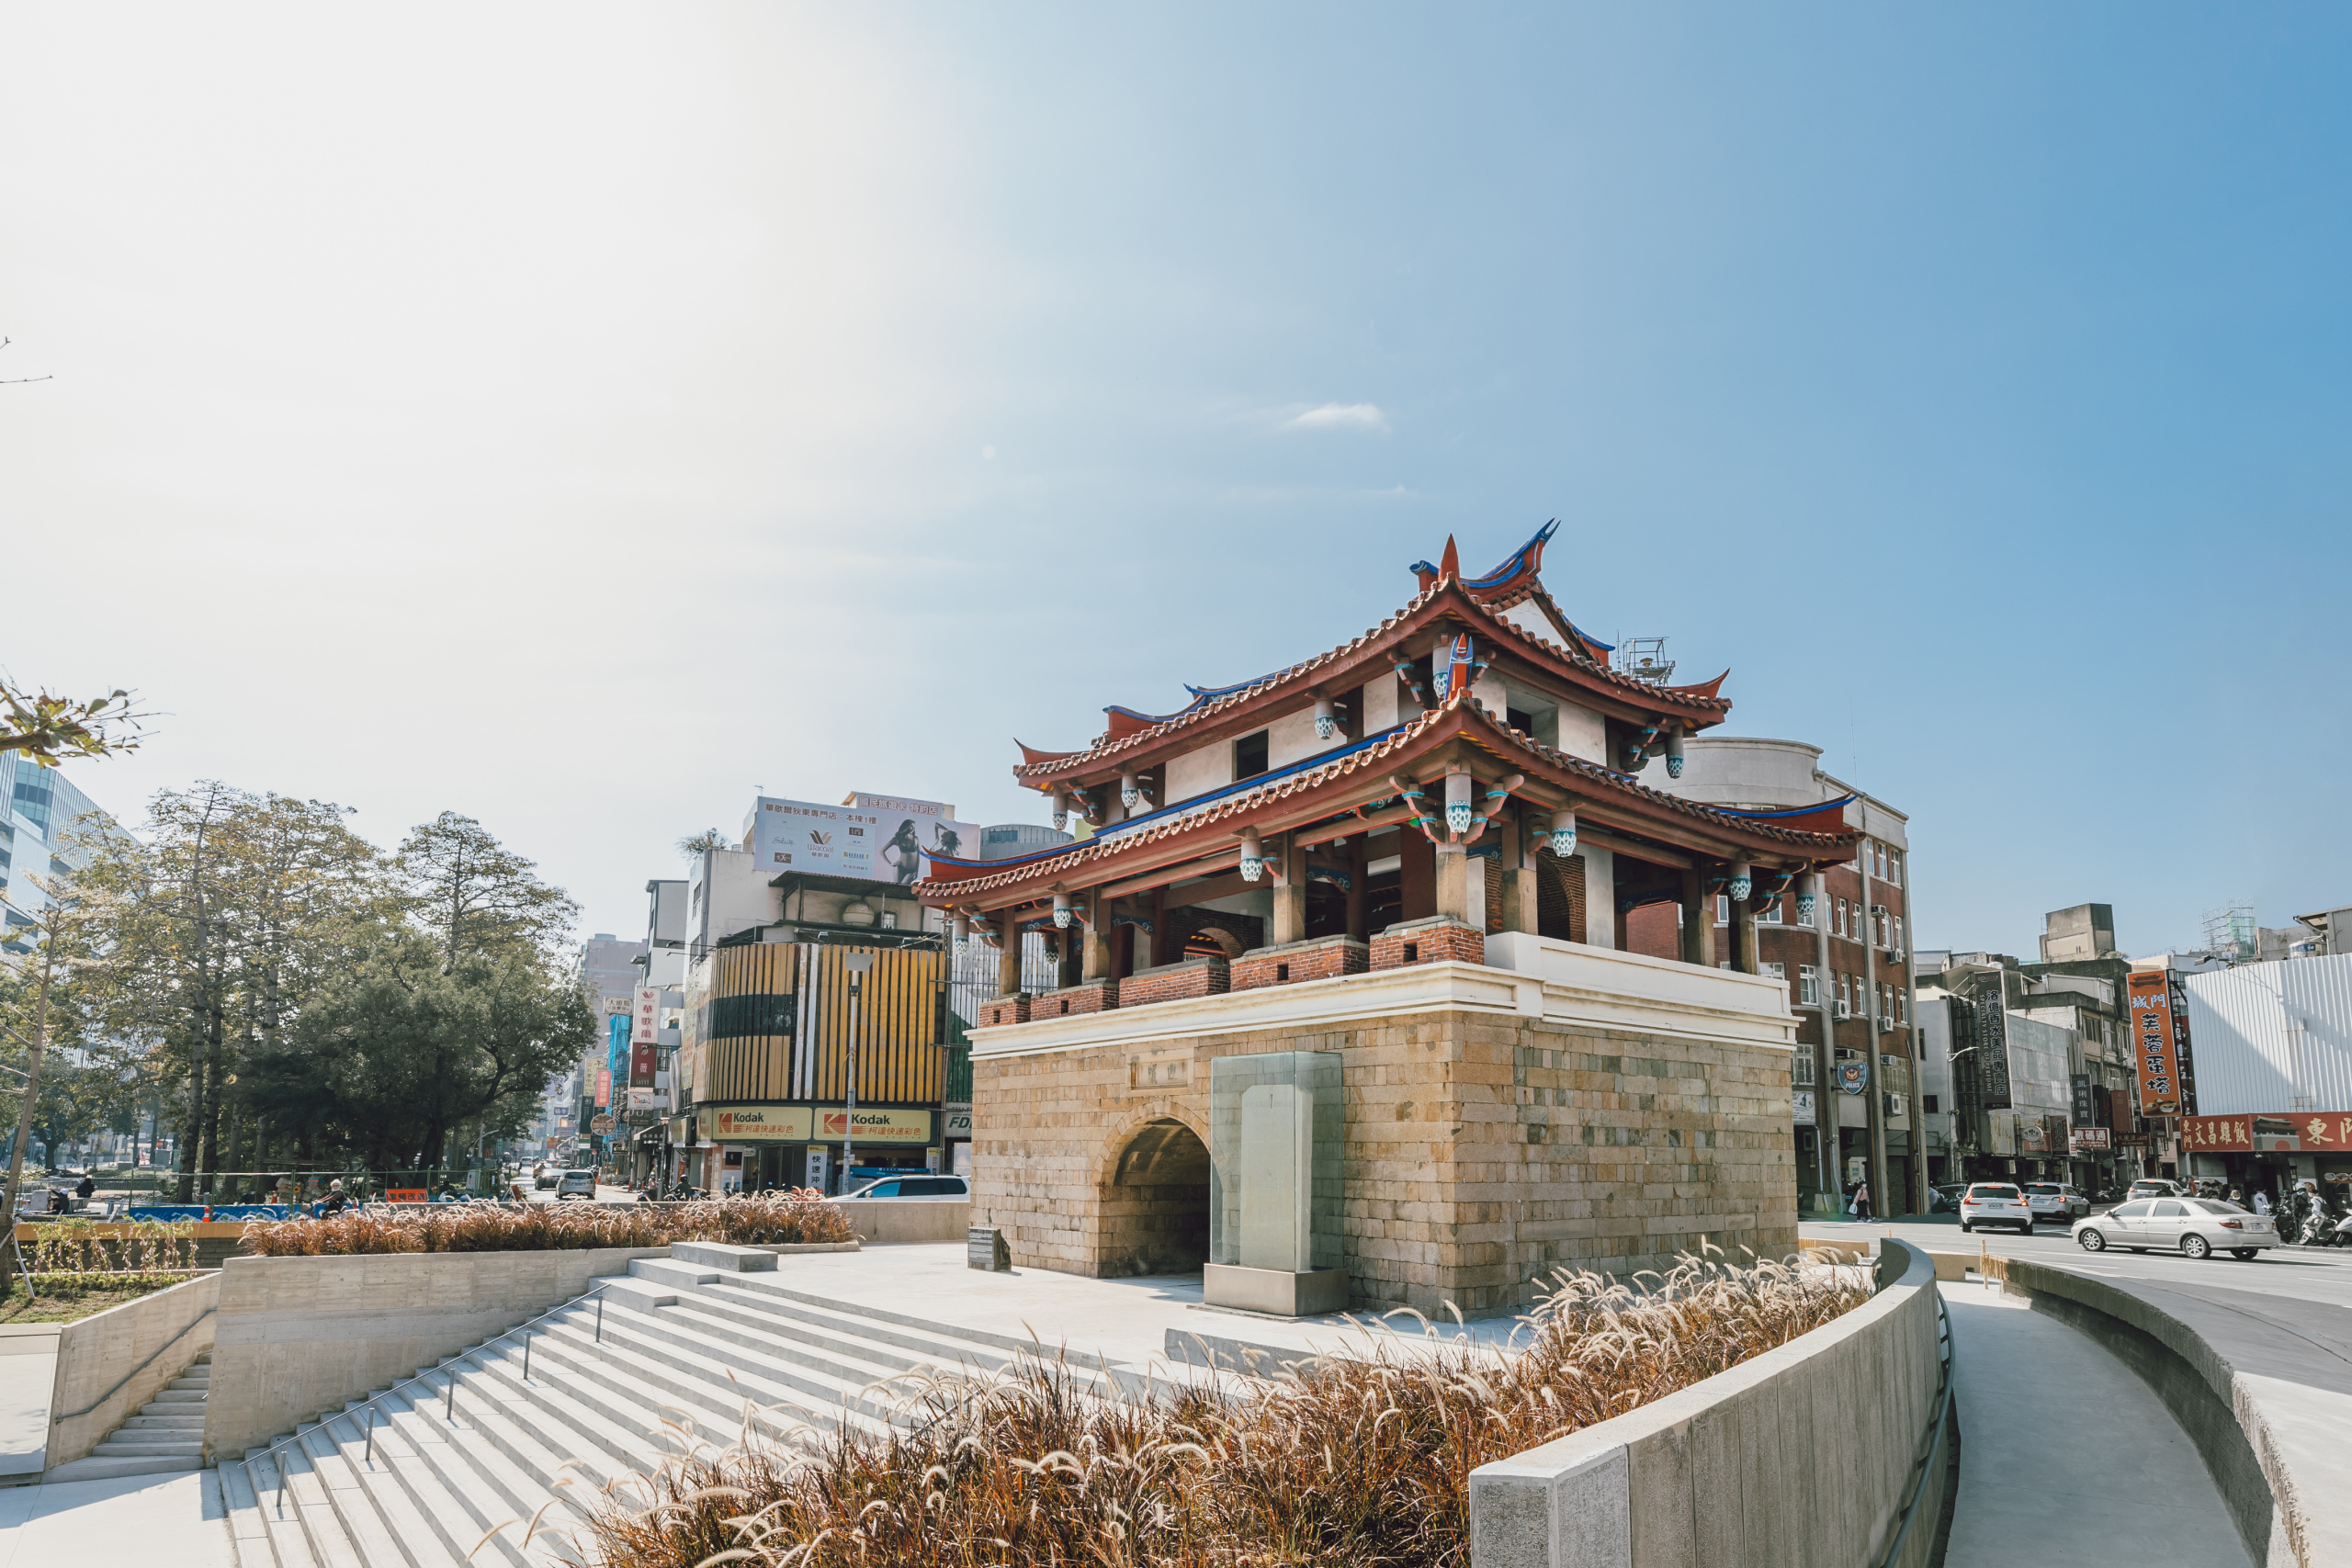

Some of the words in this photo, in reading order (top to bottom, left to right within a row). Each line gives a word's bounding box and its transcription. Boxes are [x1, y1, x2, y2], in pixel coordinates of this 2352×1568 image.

[859, 795, 907, 812] 國民旅遊卡
[910, 803, 938, 816] 特約店
[807, 843, 834, 852] Wacoal
[2132, 993, 2167, 1010] 城門
[640, 1004, 653, 1039] 華歌爾
[2141, 1012, 2171, 1095] 芙蓉蛋塔
[734, 1112, 764, 1122] Kodak
[852, 1114, 890, 1125] Kodak
[745, 1124, 794, 1134] 柯達快速彩色
[868, 1126, 922, 1136] 柯達快速彩色
[2075, 1130, 2106, 1141] 數碼通
[2183, 1119, 2193, 1149] 東門
[2195, 1121, 2249, 1145] 文昌雞飯
[811, 1155, 821, 1189] 快速沖
